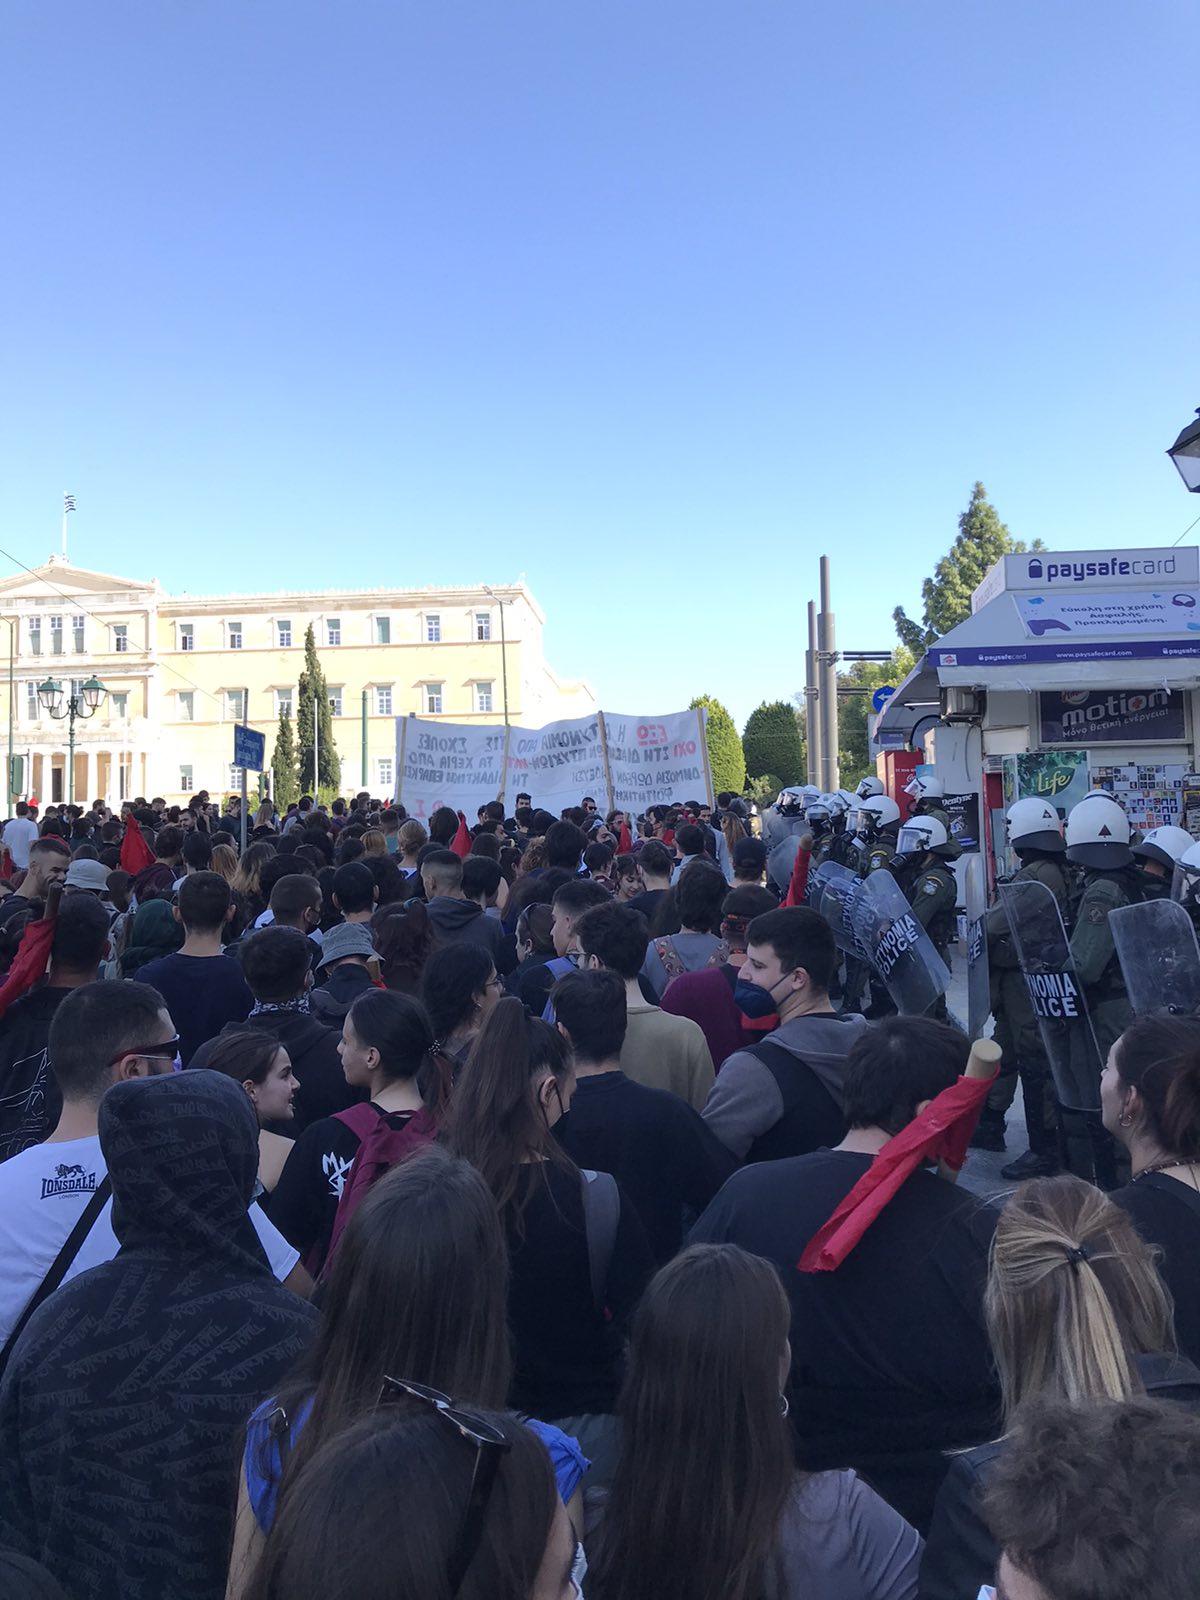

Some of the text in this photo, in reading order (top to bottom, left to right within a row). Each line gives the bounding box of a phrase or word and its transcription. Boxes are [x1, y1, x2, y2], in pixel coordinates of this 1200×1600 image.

[1048, 555, 1175, 582] paysafecard
[1060, 605, 1103, 613] Εύκολη
[1127, 603, 1167, 611] χρήση.
[1074, 618, 1168, 626] Προπληρωμένη.
[984, 653, 1027, 662] paysafecard
[1056, 650, 1133, 659] www.paysafecard.com
[1062, 689, 1169, 727] motion
[1062, 708, 1169, 738] Μόνο θετική ενέργεια!
[1038, 770, 1071, 796] Life
[41, 1172, 96, 1199] LONSDALE
